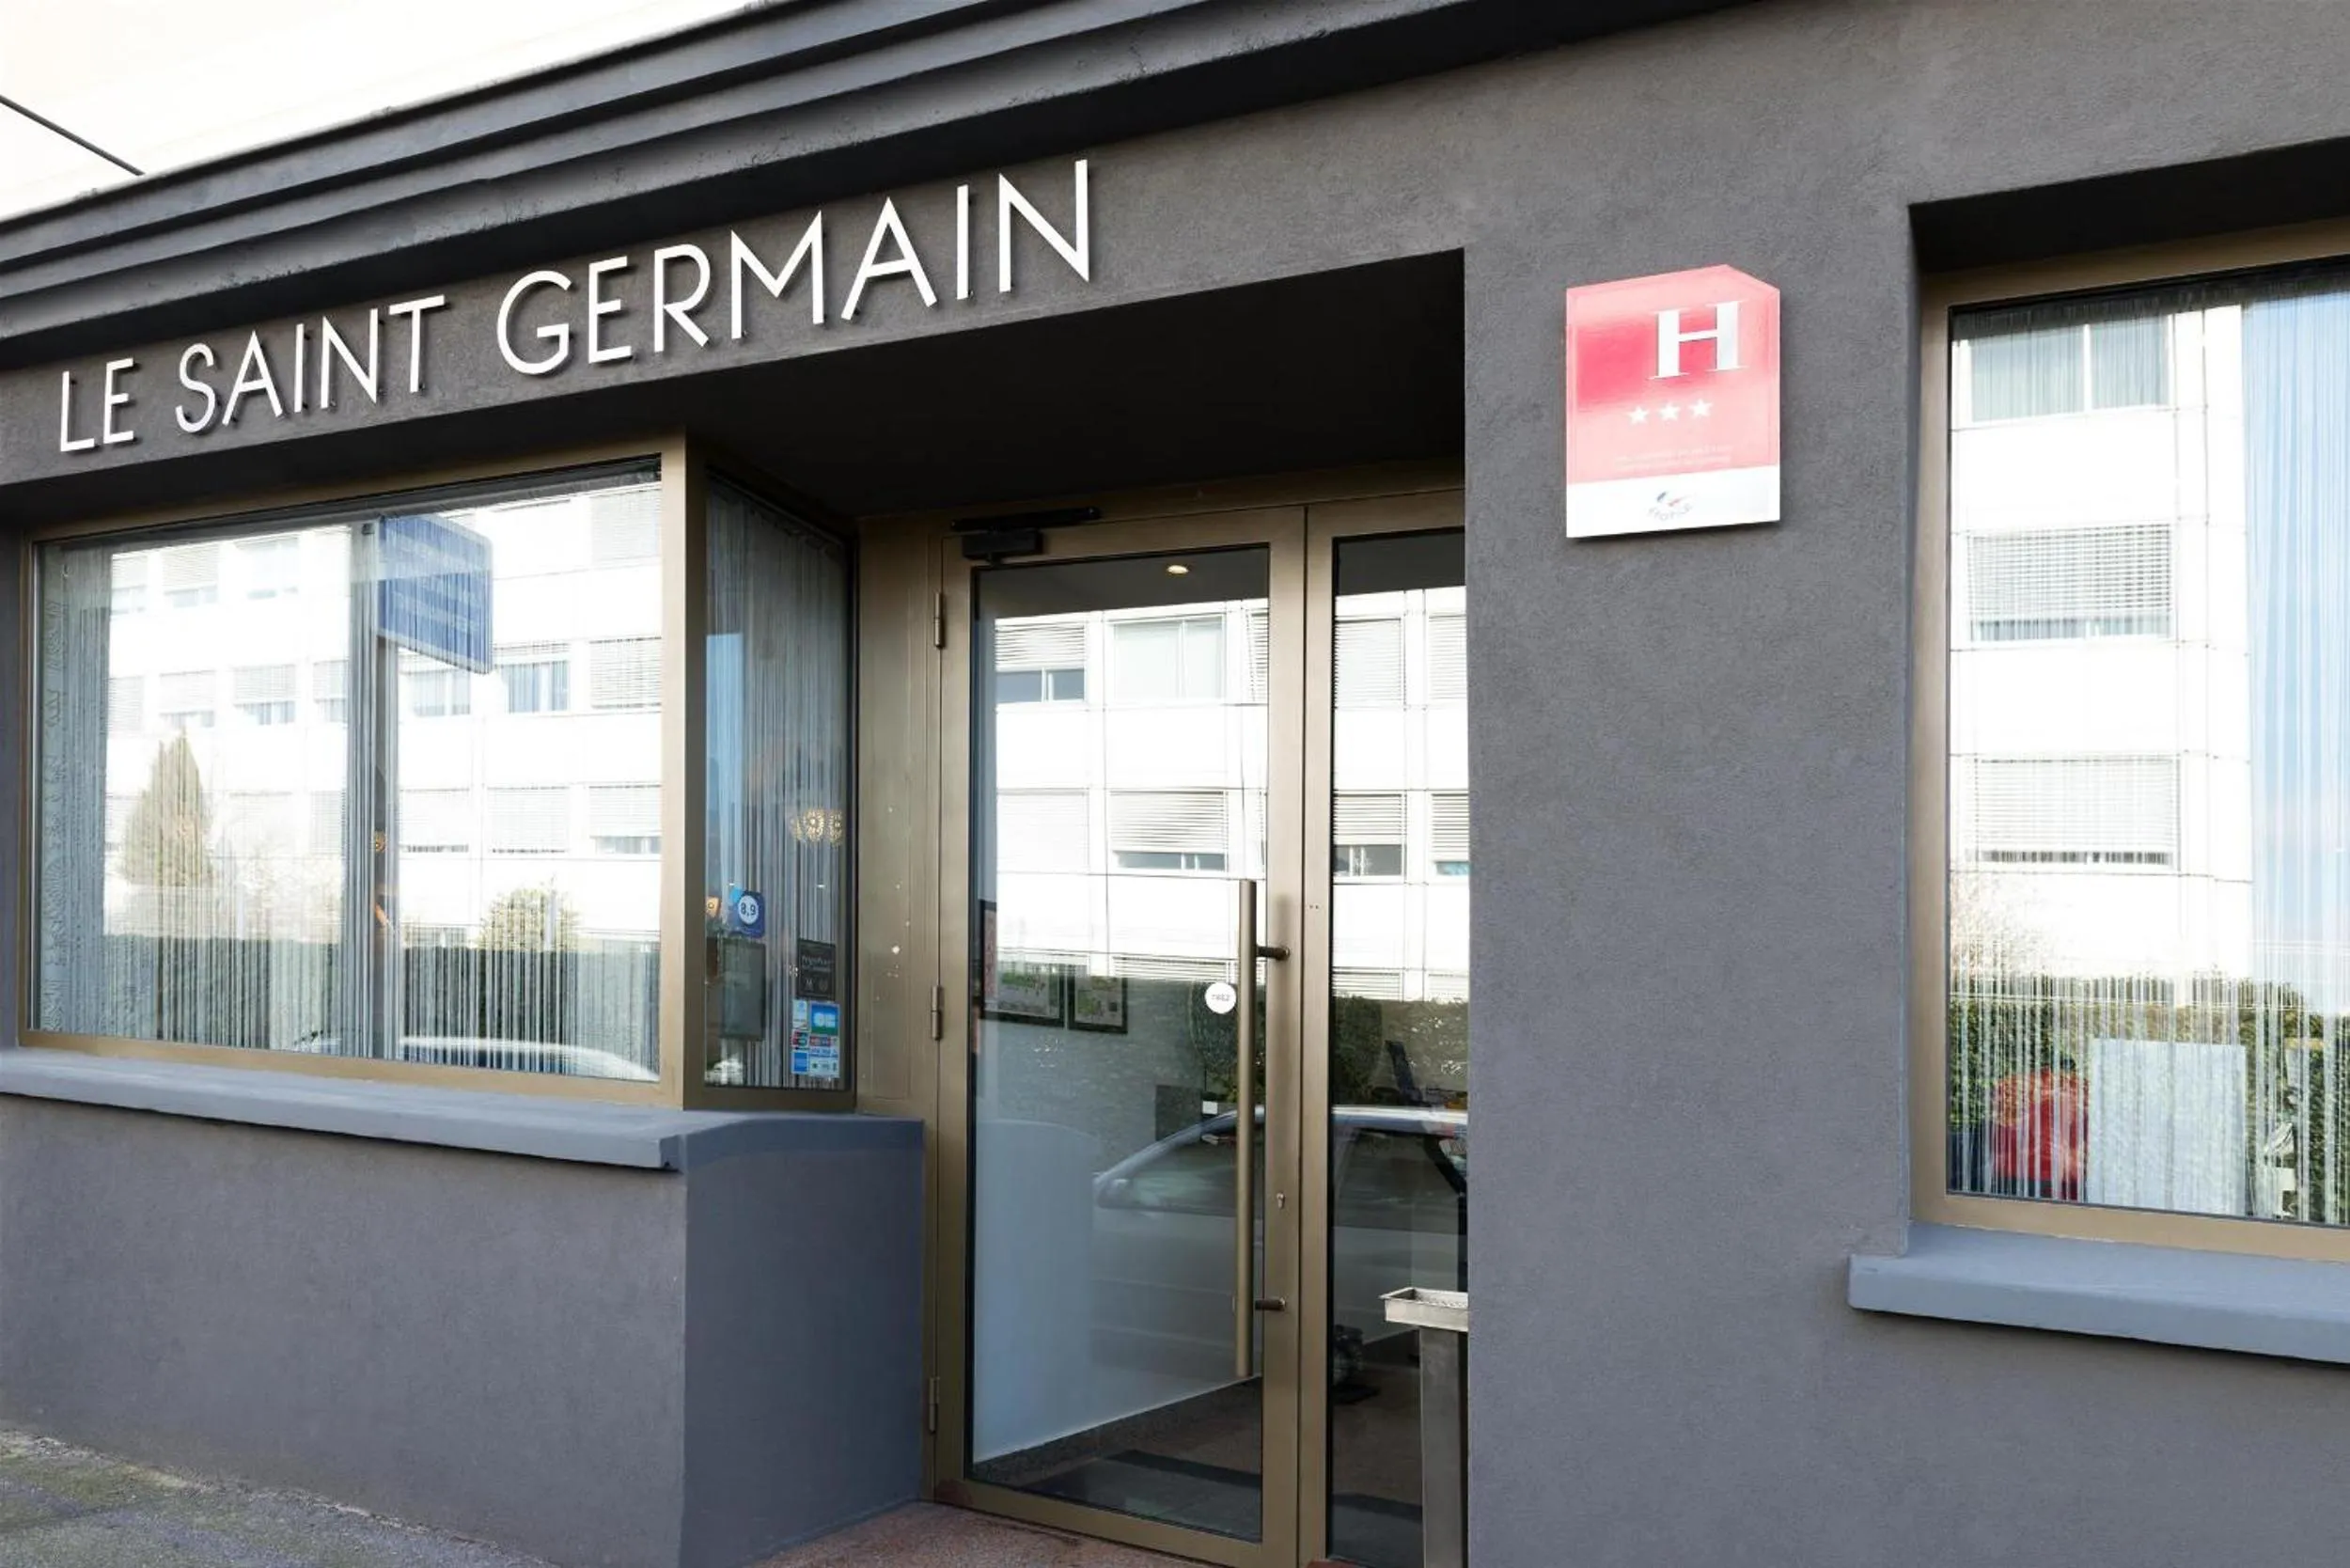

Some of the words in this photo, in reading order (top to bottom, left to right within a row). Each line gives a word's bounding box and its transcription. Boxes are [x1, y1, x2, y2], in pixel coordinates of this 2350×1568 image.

[59, 357, 134, 453] LE
[176, 294, 446, 433] SAINT
[496, 159, 1091, 375] GERMAIN
[1648, 300, 1747, 380] H
